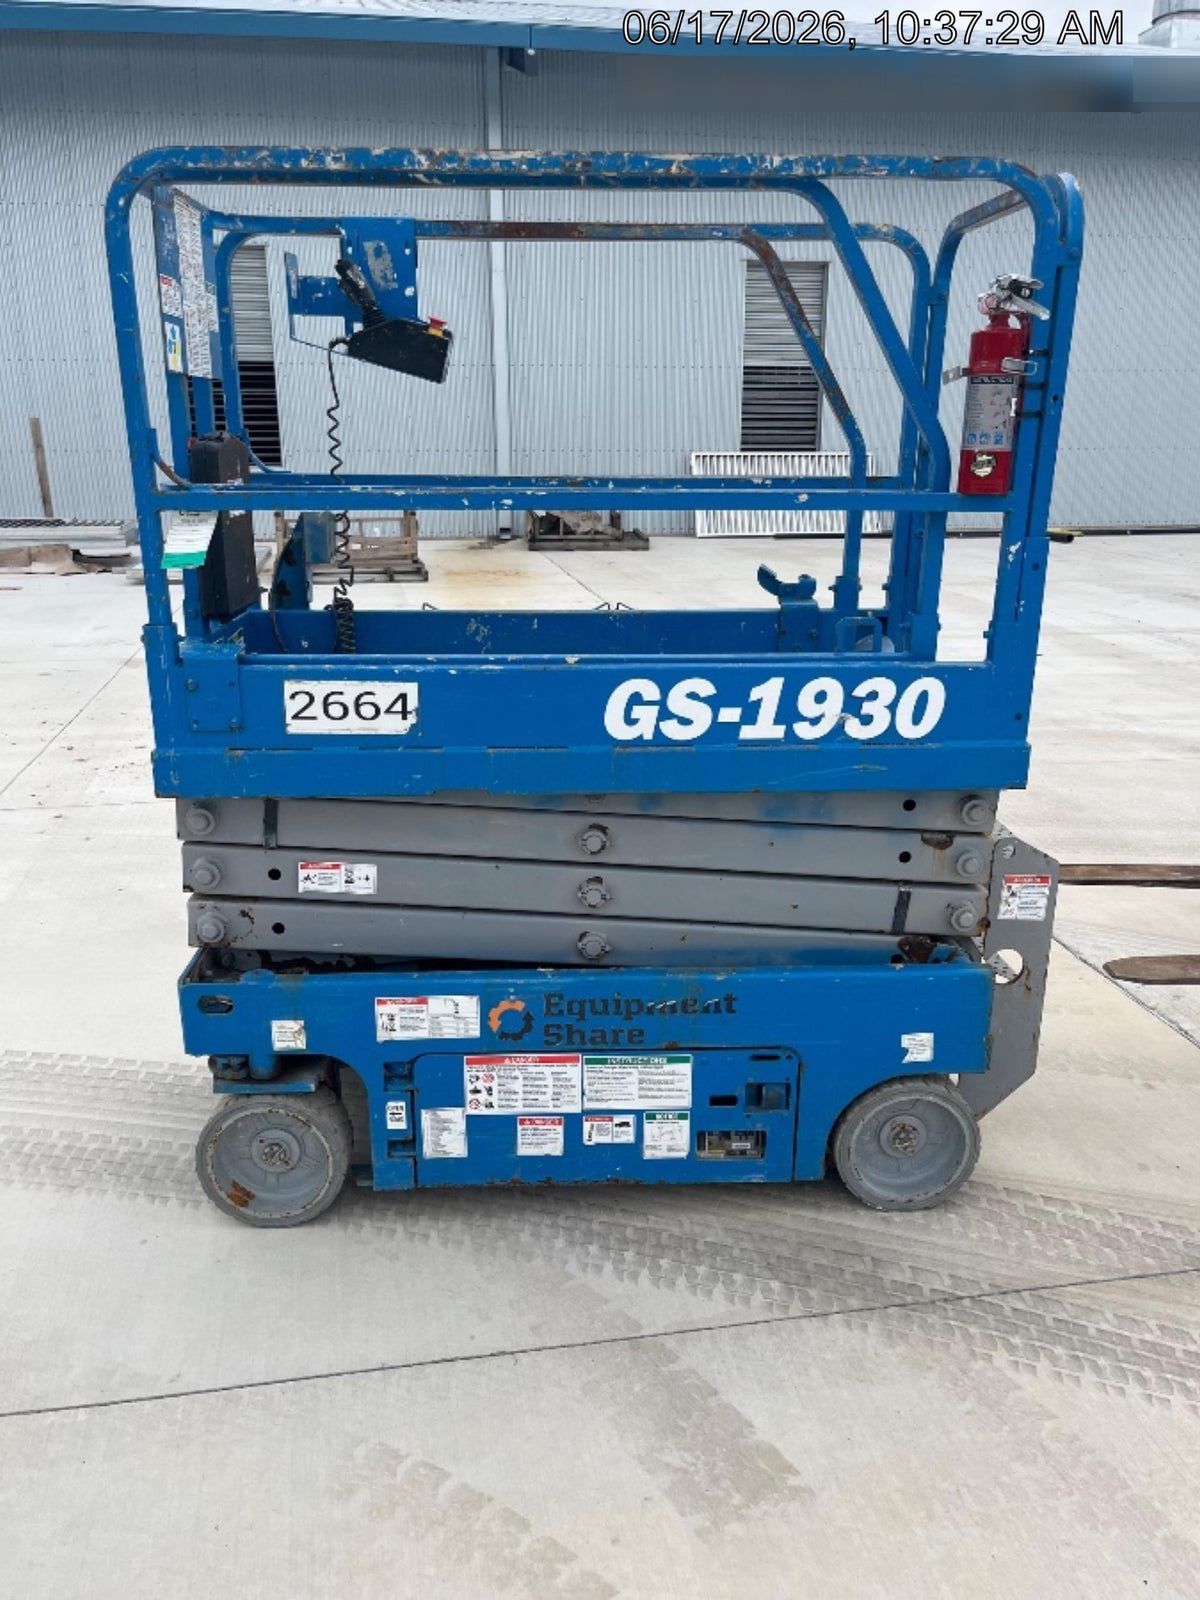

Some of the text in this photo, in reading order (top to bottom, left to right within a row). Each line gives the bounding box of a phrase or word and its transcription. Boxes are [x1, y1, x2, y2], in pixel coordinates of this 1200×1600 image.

[289, 690, 413, 721] 2664
[603, 676, 948, 741] GS-1930
[542, 992, 738, 1022] Equipment
[542, 1024, 645, 1046] Share
